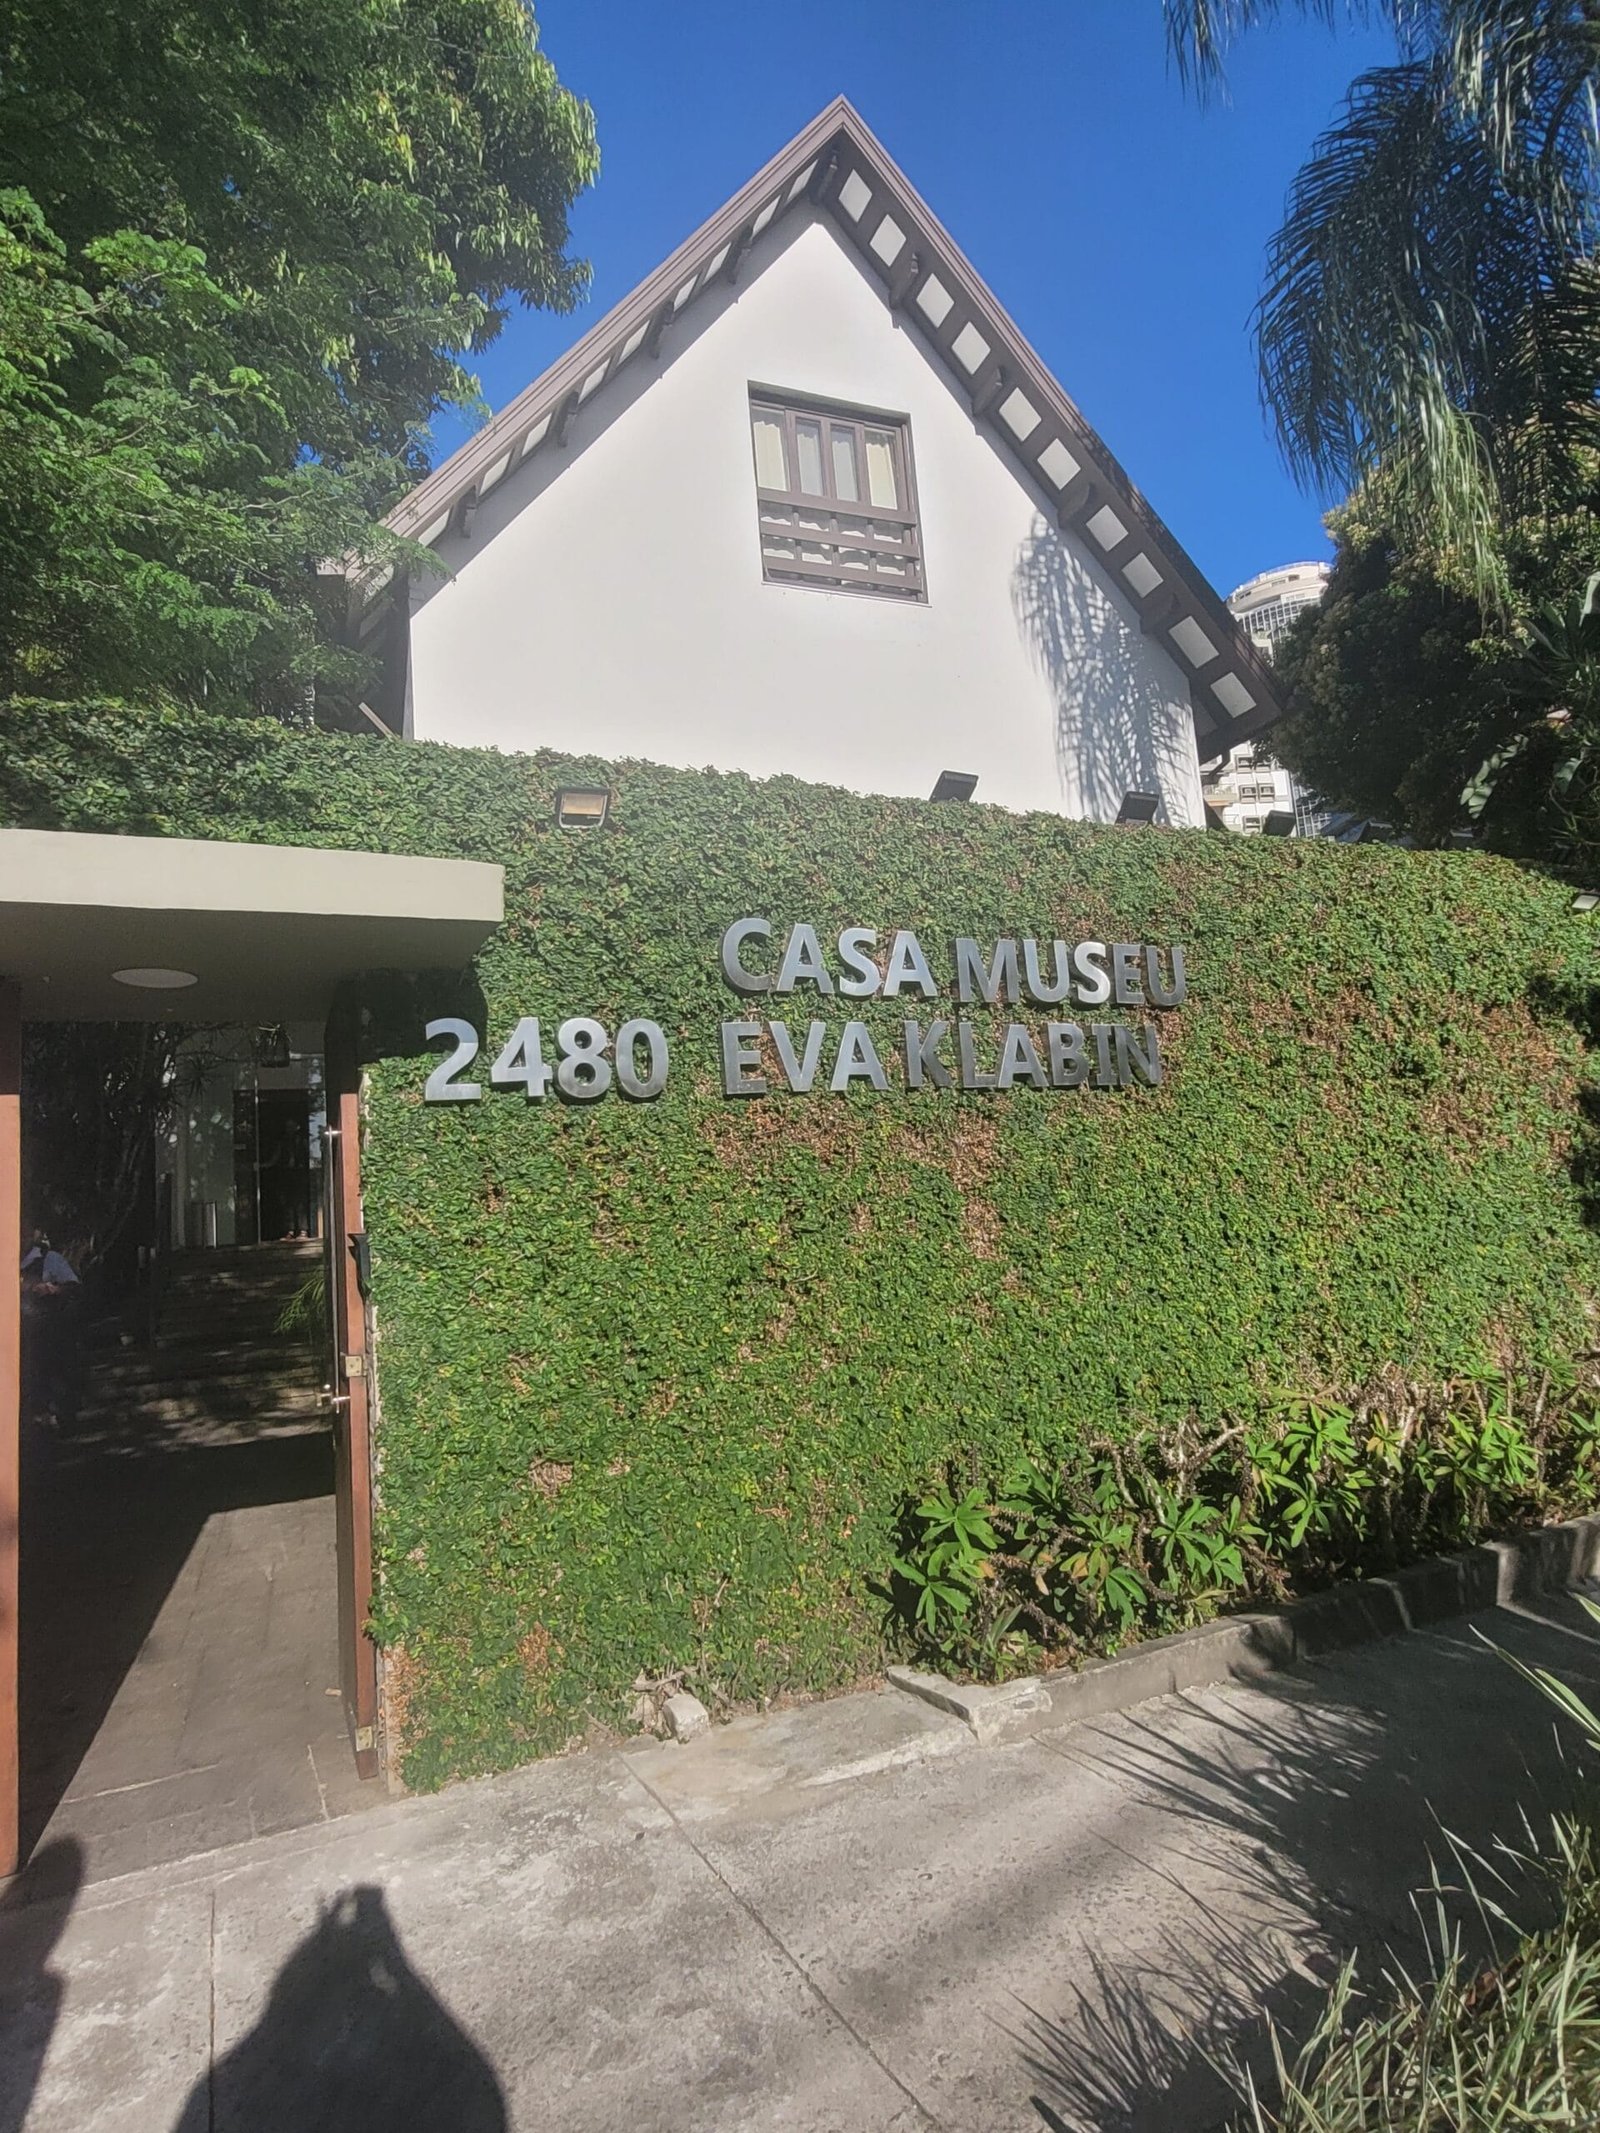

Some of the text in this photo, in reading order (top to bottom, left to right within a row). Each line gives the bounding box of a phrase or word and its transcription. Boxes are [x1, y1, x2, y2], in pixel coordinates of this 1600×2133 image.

[722, 917, 1188, 1007] CASA MUSEU
[424, 1016, 668, 1102] 2480
[722, 1020, 1163, 1096] EVA KLABIN
